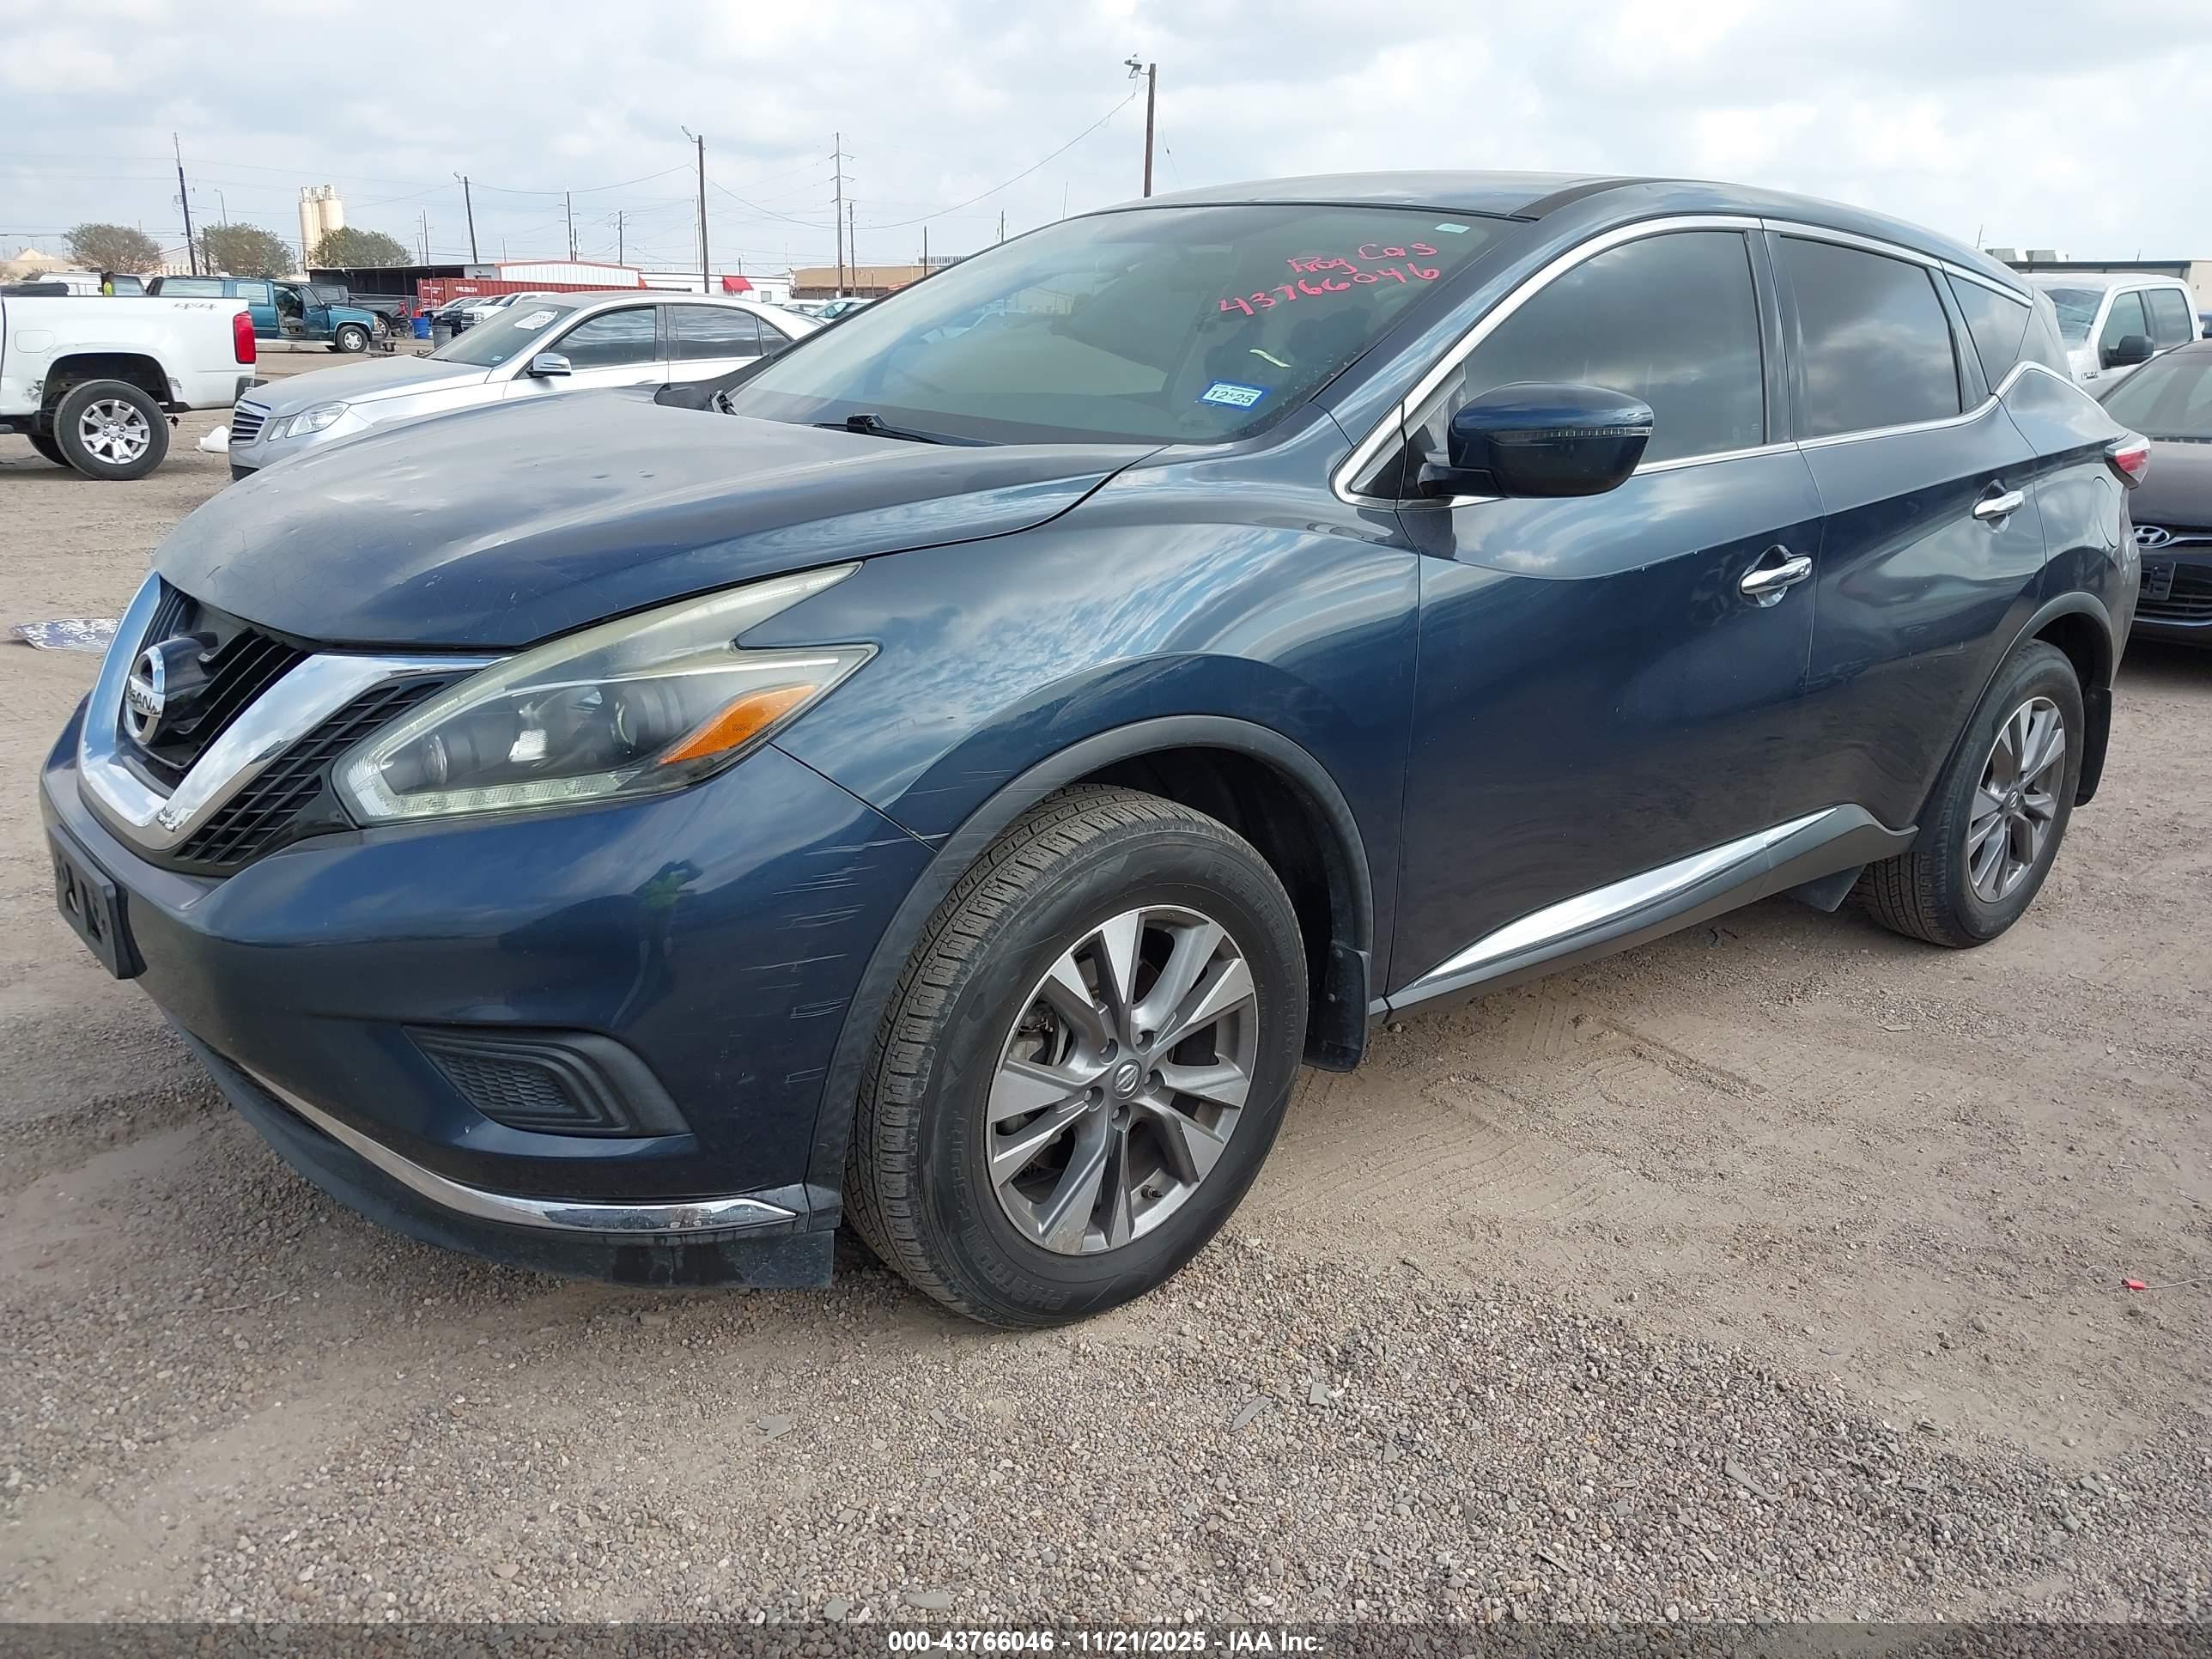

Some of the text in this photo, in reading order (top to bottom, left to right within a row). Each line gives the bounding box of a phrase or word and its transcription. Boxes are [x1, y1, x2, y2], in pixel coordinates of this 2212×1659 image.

[1219, 262, 1441, 316] 43766046
[1210, 390, 1228, 399] 12
[1232, 393, 1255, 404] 25
